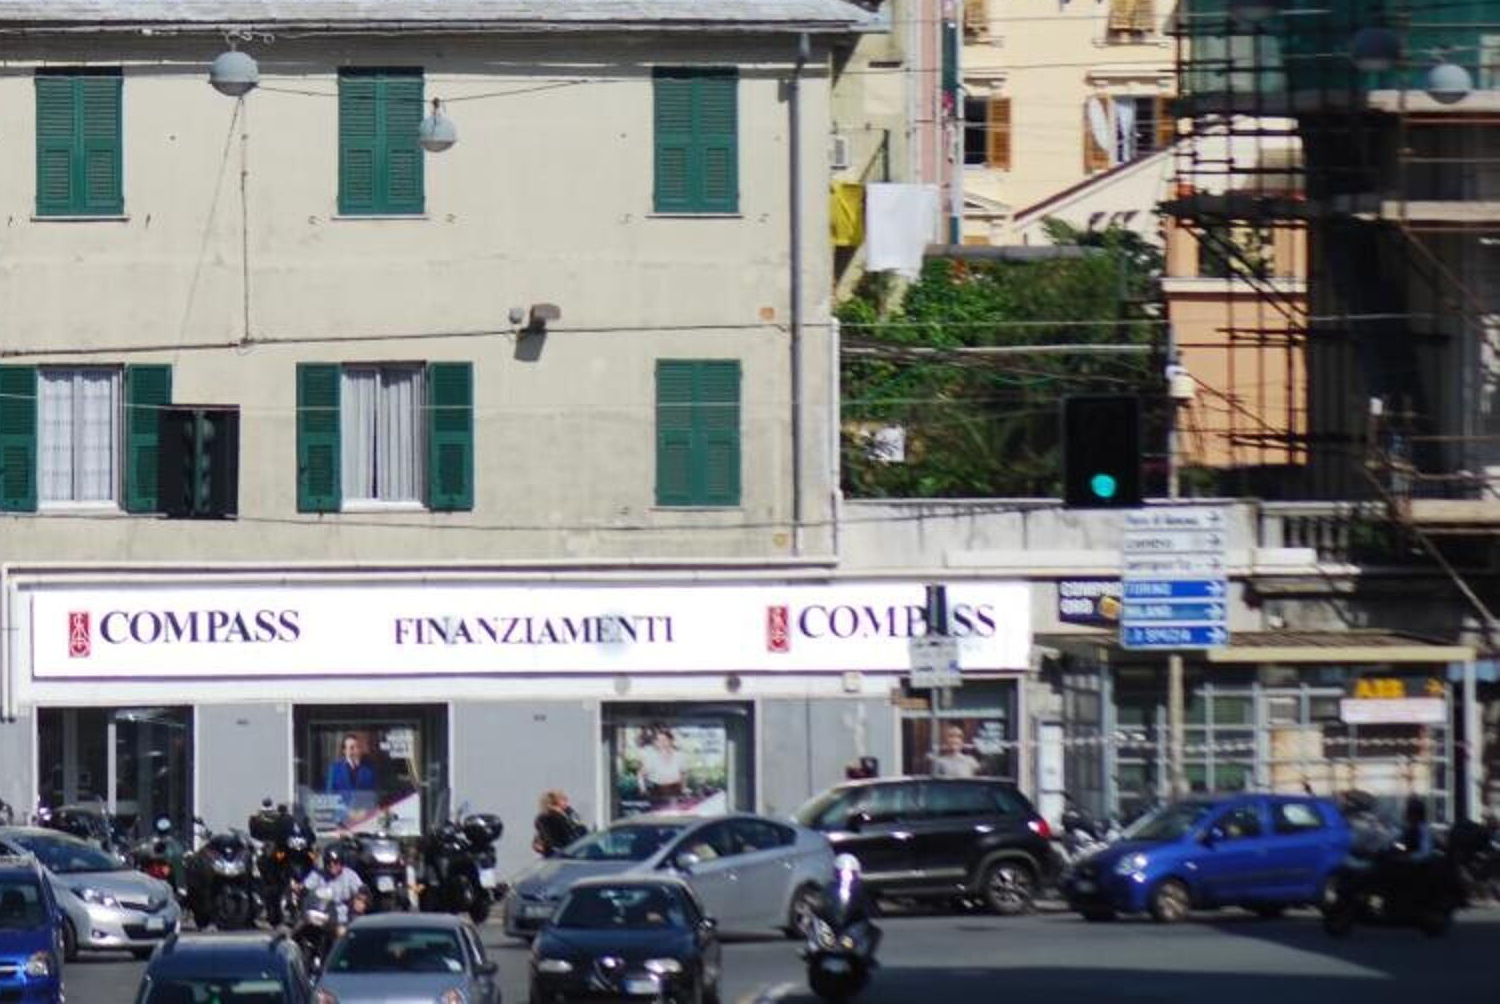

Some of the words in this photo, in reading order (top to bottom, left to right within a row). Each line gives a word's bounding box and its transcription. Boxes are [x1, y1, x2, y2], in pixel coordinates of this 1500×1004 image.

[99, 609, 301, 644] COMPASS
[395, 614, 674, 645] FINANZIAMENTI
[799, 604, 997, 639] COMPSS
